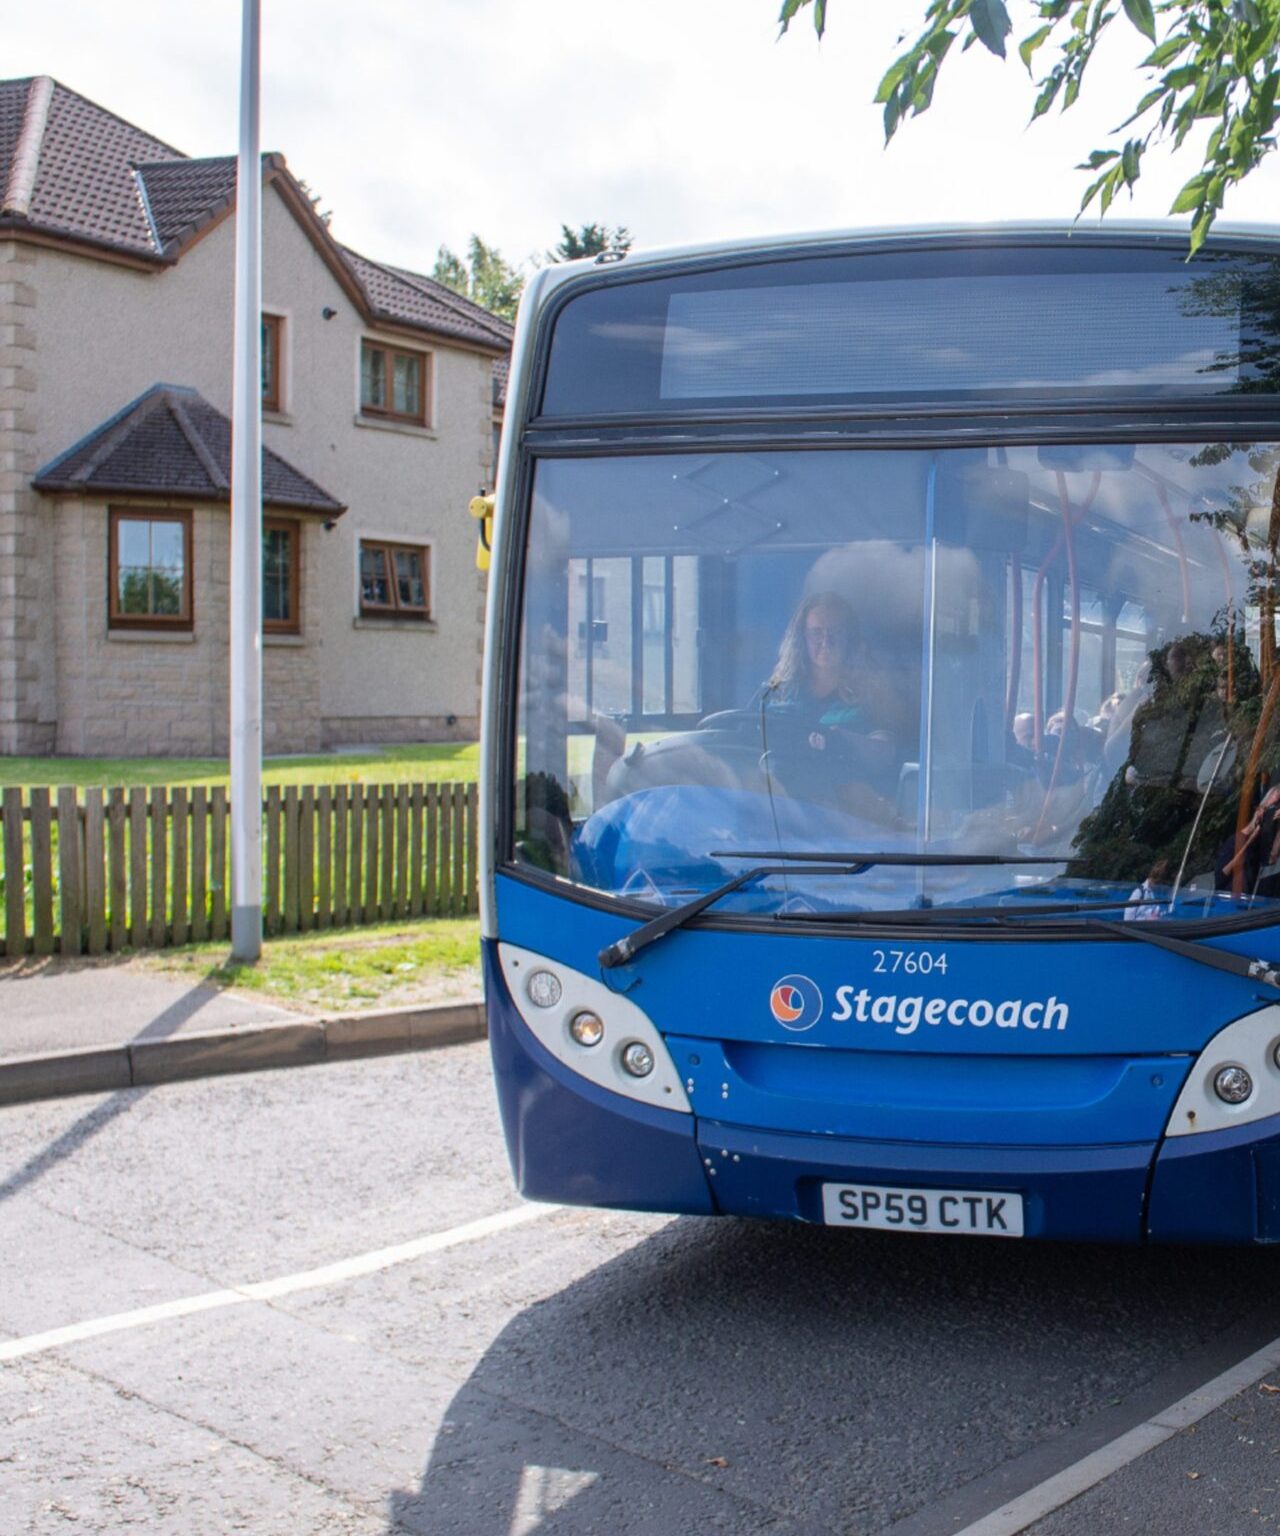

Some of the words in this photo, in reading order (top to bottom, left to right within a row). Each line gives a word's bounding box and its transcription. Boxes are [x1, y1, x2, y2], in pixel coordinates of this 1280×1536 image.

[872, 950, 948, 975] 27604
[831, 985, 1069, 1035] Stagecoach
[838, 1189, 928, 1226] SP59
[938, 1195, 1008, 1230] CTK
